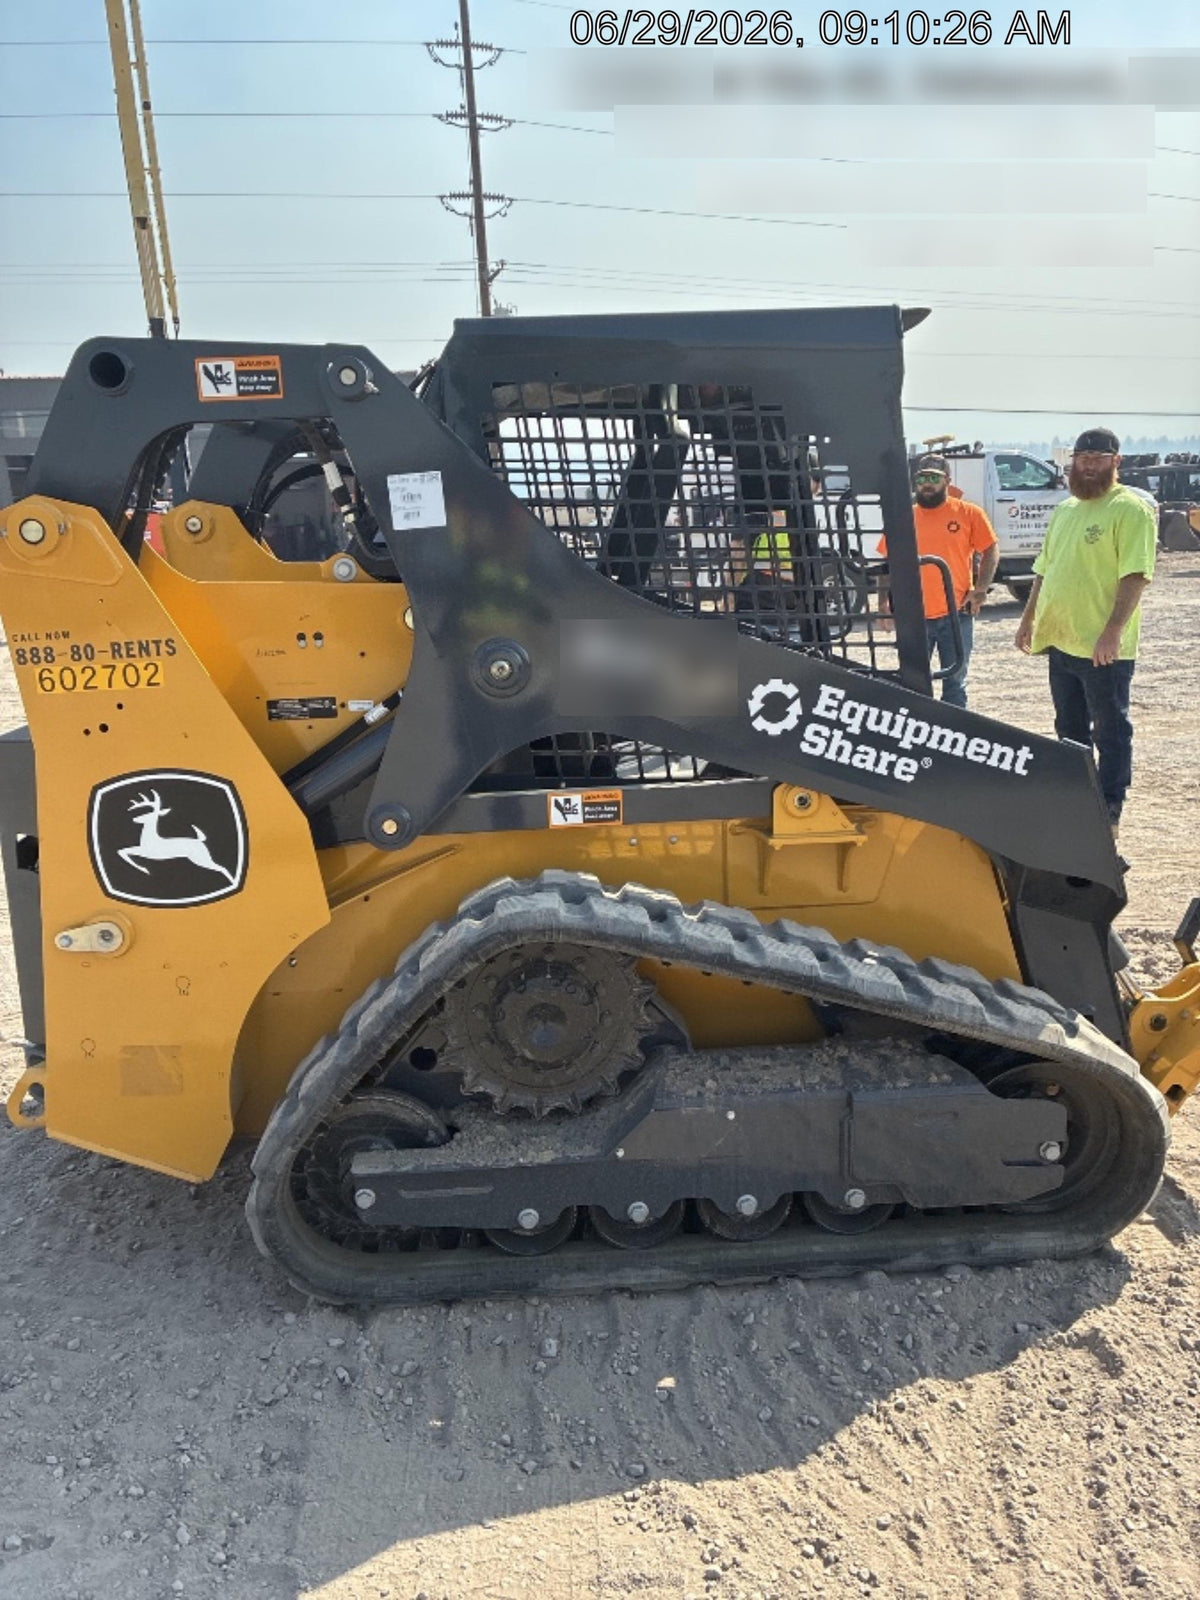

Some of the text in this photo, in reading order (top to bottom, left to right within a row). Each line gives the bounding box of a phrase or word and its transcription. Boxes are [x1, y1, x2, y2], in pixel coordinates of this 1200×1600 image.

[12, 630, 71, 643] CALL NOW
[15, 638, 177, 666] 888-80-RENTS
[38, 662, 161, 693] 602702
[812, 683, 1034, 776] Equipment
